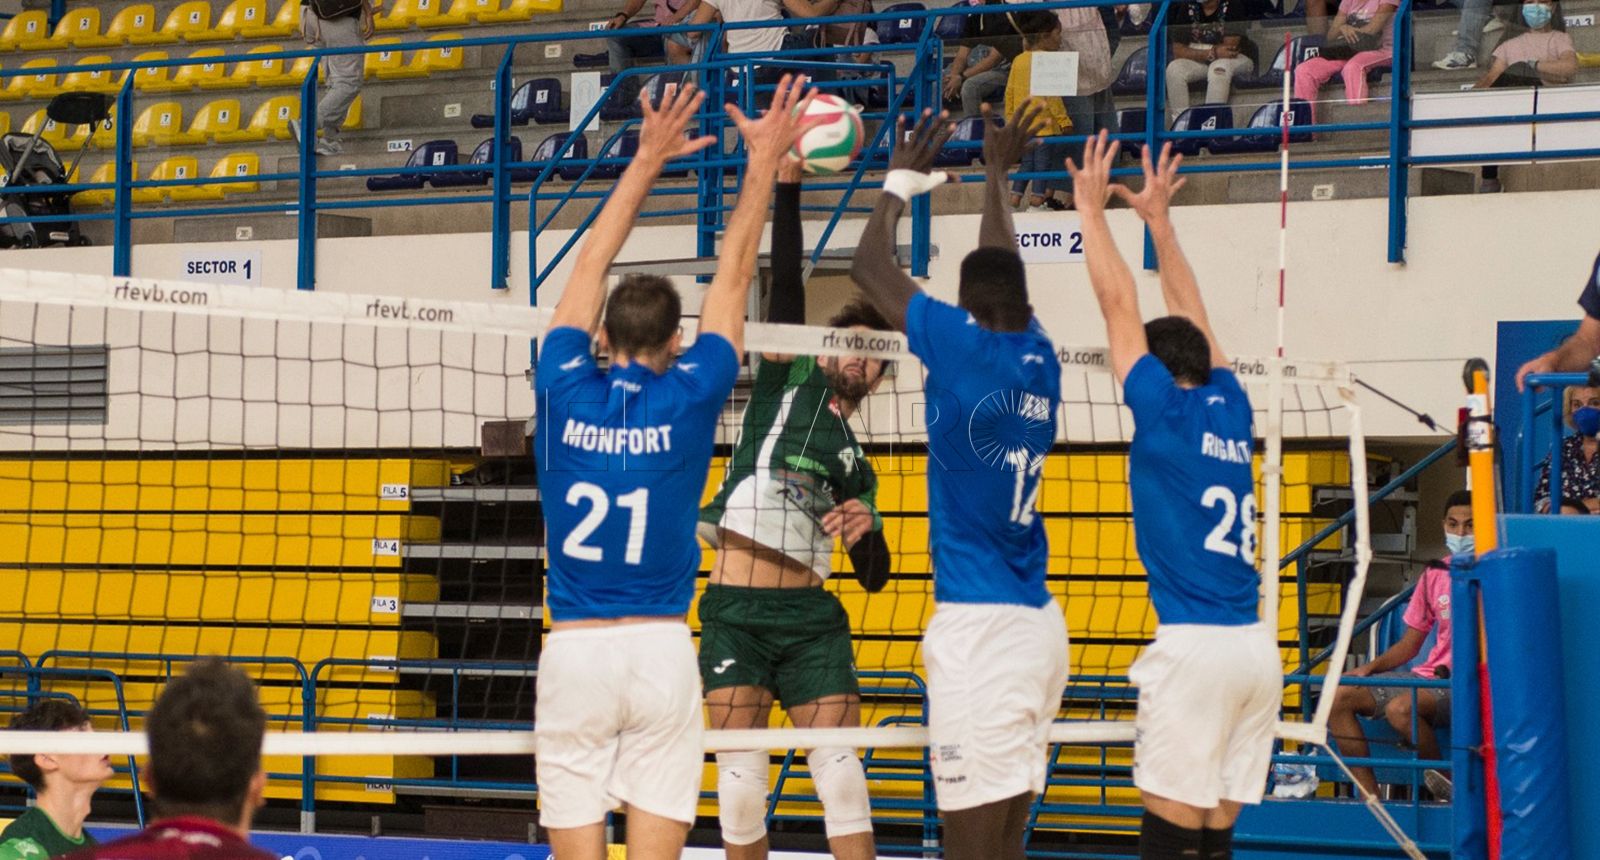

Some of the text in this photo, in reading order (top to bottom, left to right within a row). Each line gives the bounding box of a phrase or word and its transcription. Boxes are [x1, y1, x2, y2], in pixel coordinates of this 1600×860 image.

[388, 142, 411, 151] FILA 2
[238, 165, 247, 173] 10
[1015, 232, 1083, 254] ECTOR 2
[187, 259, 252, 280] SECTOR 1
[115, 281, 208, 305] rfevb.com
[562, 418, 672, 455] MONFORT
[383, 486, 407, 498] FILA 5
[562, 481, 649, 565] 21
[1201, 485, 1257, 566] 28
[374, 540, 397, 553] FILA 4
[373, 599, 396, 611] FILA 3
